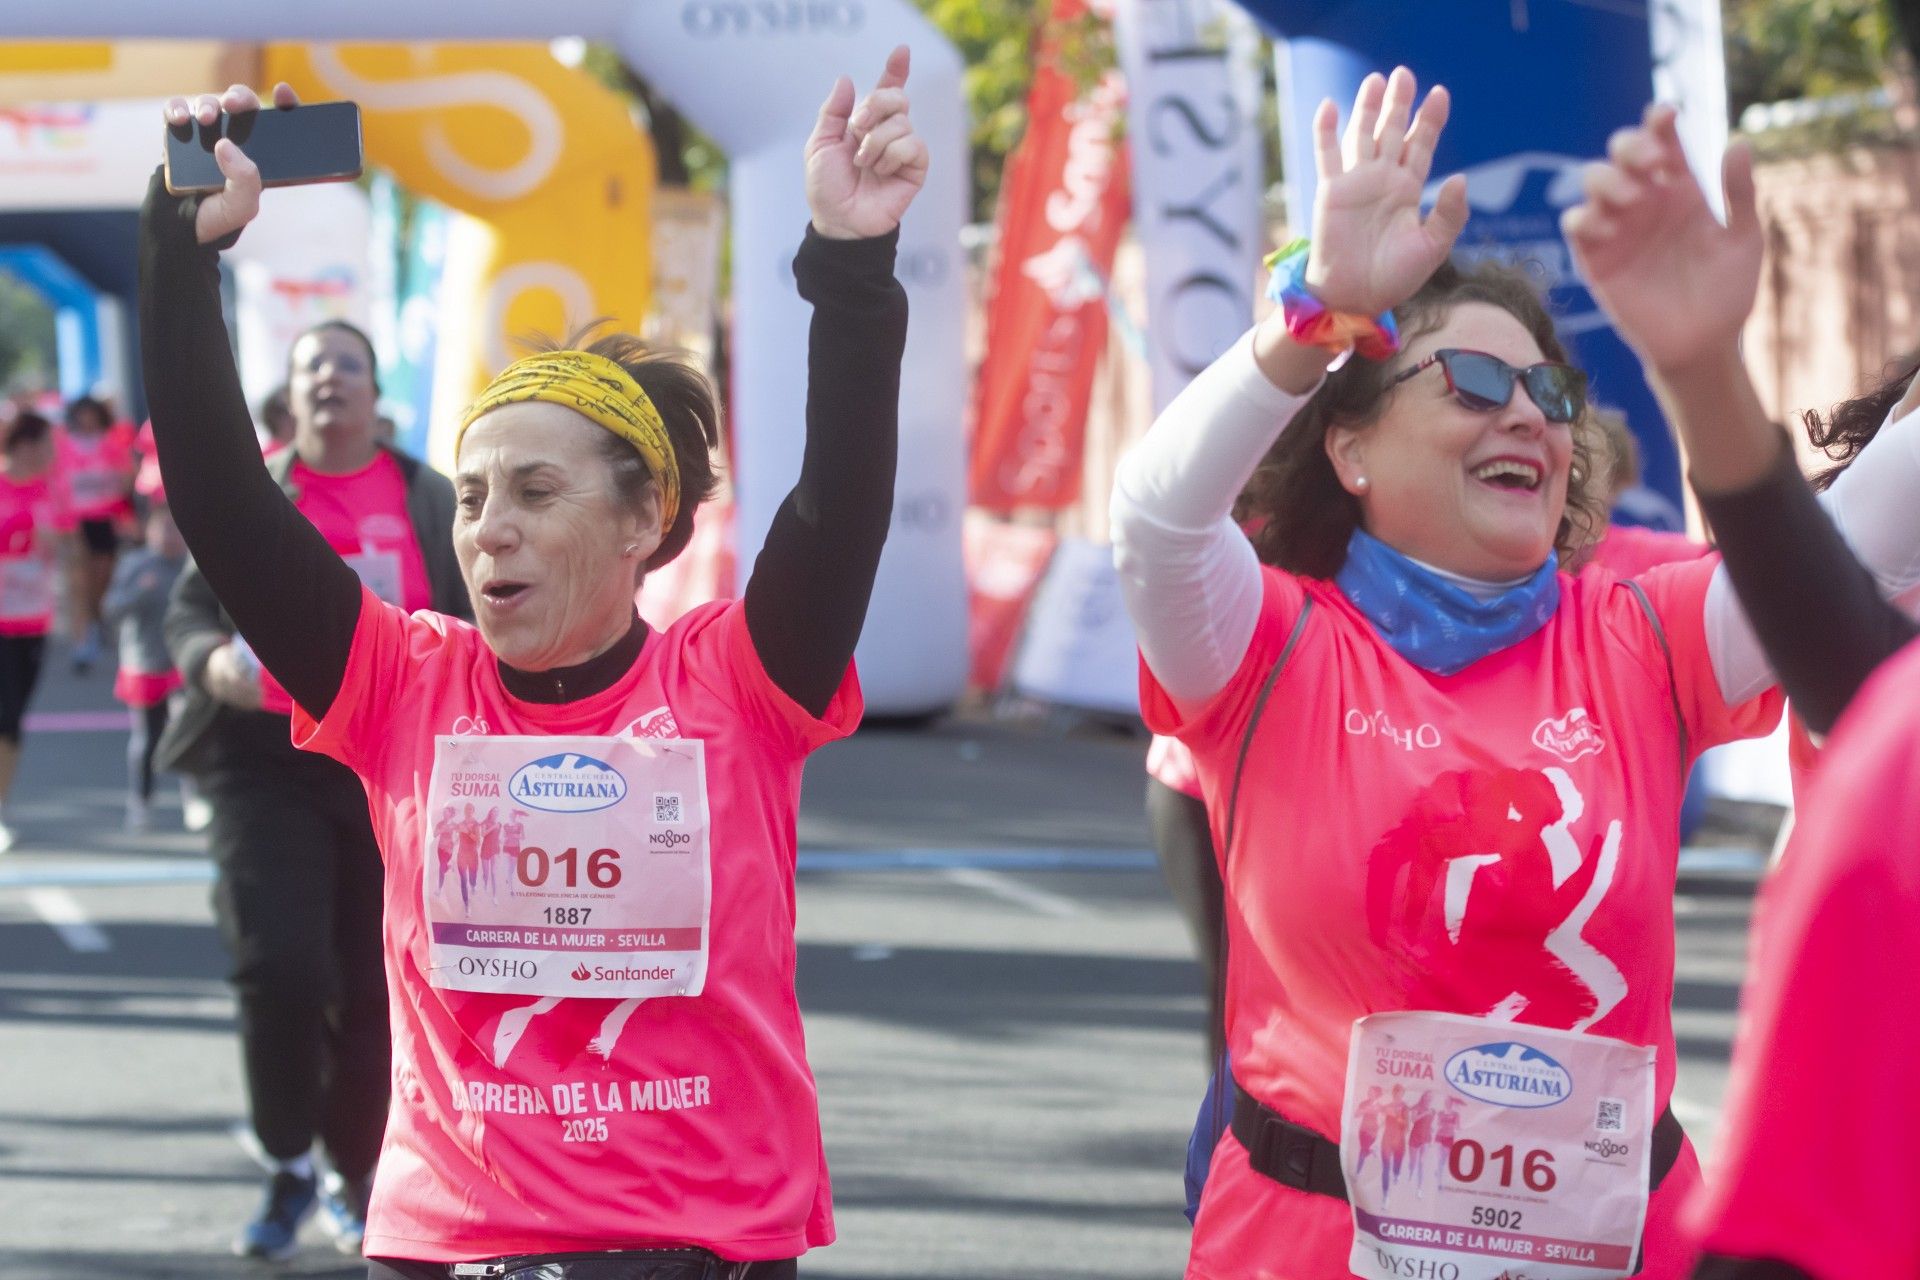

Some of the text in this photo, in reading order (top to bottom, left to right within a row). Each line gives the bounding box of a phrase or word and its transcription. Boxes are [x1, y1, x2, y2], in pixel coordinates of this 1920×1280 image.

[451, 783, 500, 797] SUMA
[465, 773, 500, 782] DORSAL
[516, 847, 622, 889] 016
[543, 906, 592, 925] 1887
[466, 929, 666, 947] CARRERA DE LA MUJER SEVILLA
[458, 956, 675, 981] OYSHO Santander
[1376, 1058, 1434, 1080] SUMA
[552, 1082, 588, 1116] DE
[592, 1081, 624, 1112] LA
[631, 1075, 711, 1111] MUJER
[562, 1117, 609, 1143] 2025
[1448, 1139, 1557, 1193] 016
[1471, 1206, 1523, 1230] 5902
[1379, 1222, 1596, 1262] CARRERA DE LA MUJER SEVILLA
[1374, 1247, 1459, 1280] OYSHO
